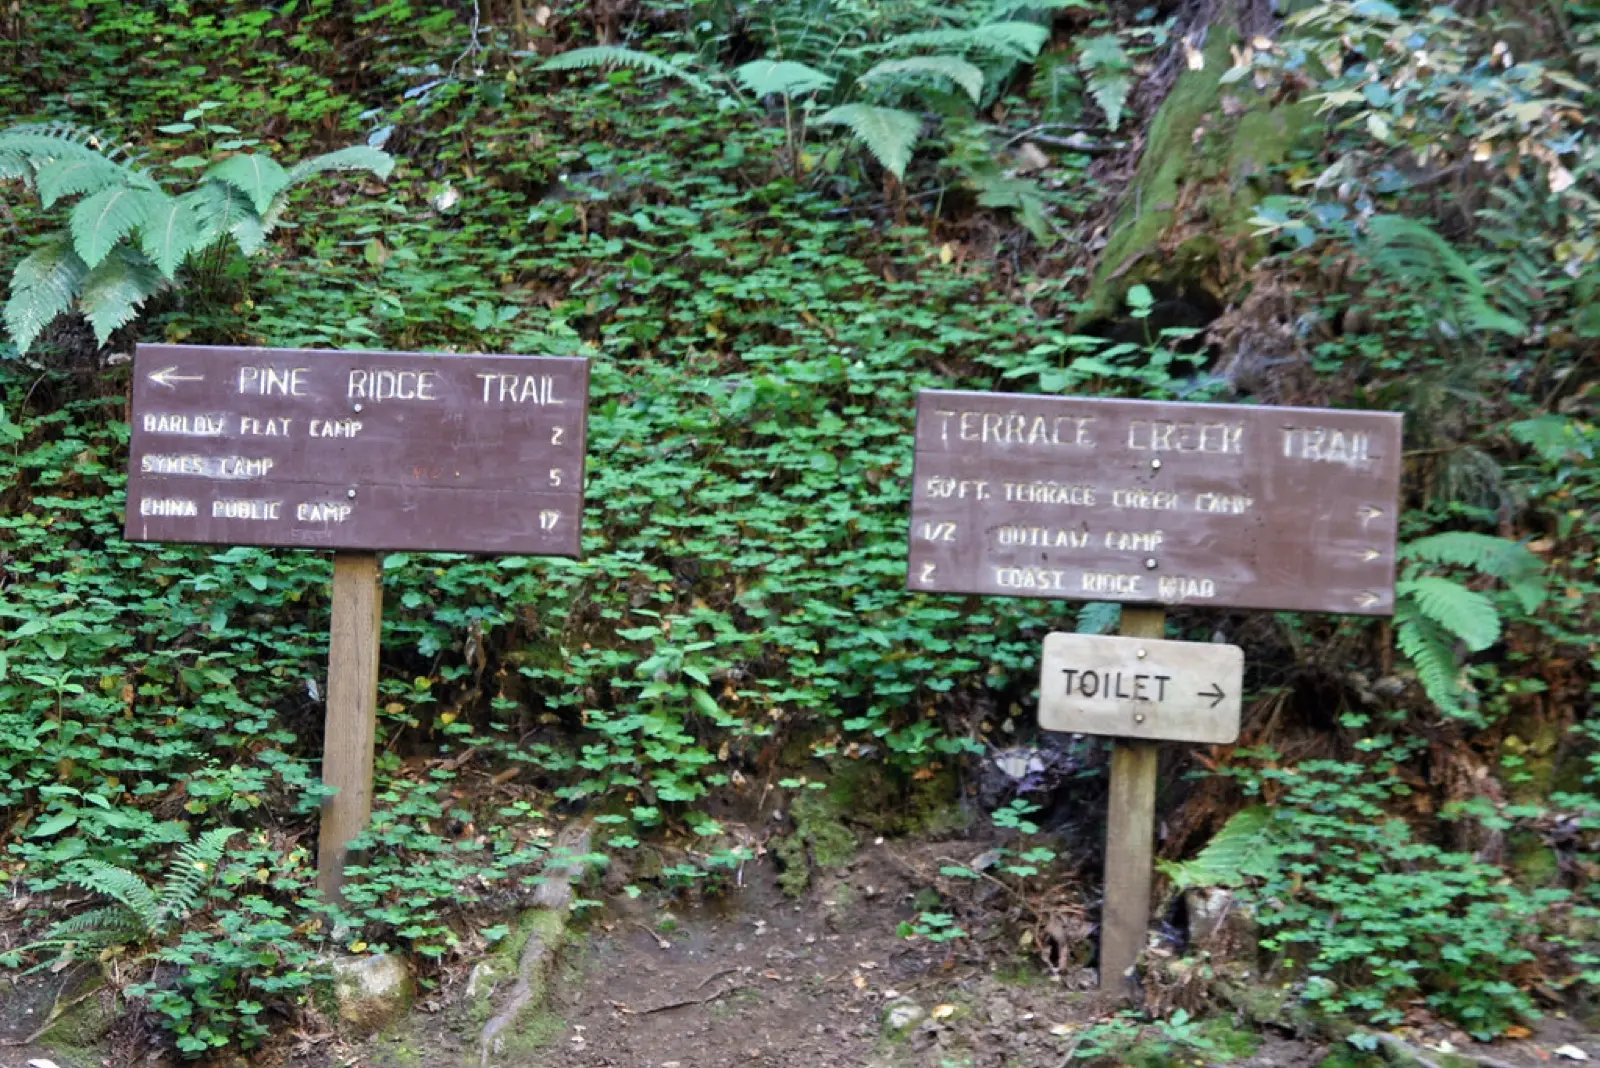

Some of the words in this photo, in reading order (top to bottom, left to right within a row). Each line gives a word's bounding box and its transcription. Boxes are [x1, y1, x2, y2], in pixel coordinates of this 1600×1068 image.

[239, 366, 312, 396] PINE
[347, 369, 436, 402] RIDGE
[476, 372, 564, 406] TRAIL
[143, 414, 224, 435] BARLOW
[240, 416, 292, 437] FLAT
[309, 418, 363, 438] CAMP
[551, 426, 564, 446] 2
[935, 410, 1097, 449] TERRACE
[1128, 420, 1245, 454] CREEK
[1280, 425, 1378, 463] TRAIL
[220, 456, 274, 477] CAMP
[549, 468, 562, 487] 5
[140, 498, 198, 517] CHINA
[212, 500, 281, 520] PUBLIC
[297, 502, 352, 522] CAMP
[538, 509, 560, 530] 17
[1002, 481, 1097, 506] TERRACE
[1112, 488, 1179, 510] CREEK
[1195, 493, 1255, 514] CAMP
[923, 522, 956, 542] 1/2
[999, 525, 1089, 548] OUTLAW
[1105, 530, 1164, 552] CAMP
[919, 562, 936, 584] 2
[996, 567, 1066, 590] COAST
[1081, 572, 1143, 594] RIDGE
[1158, 575, 1215, 600] ROAD
[1062, 669, 1171, 702] TOILET
